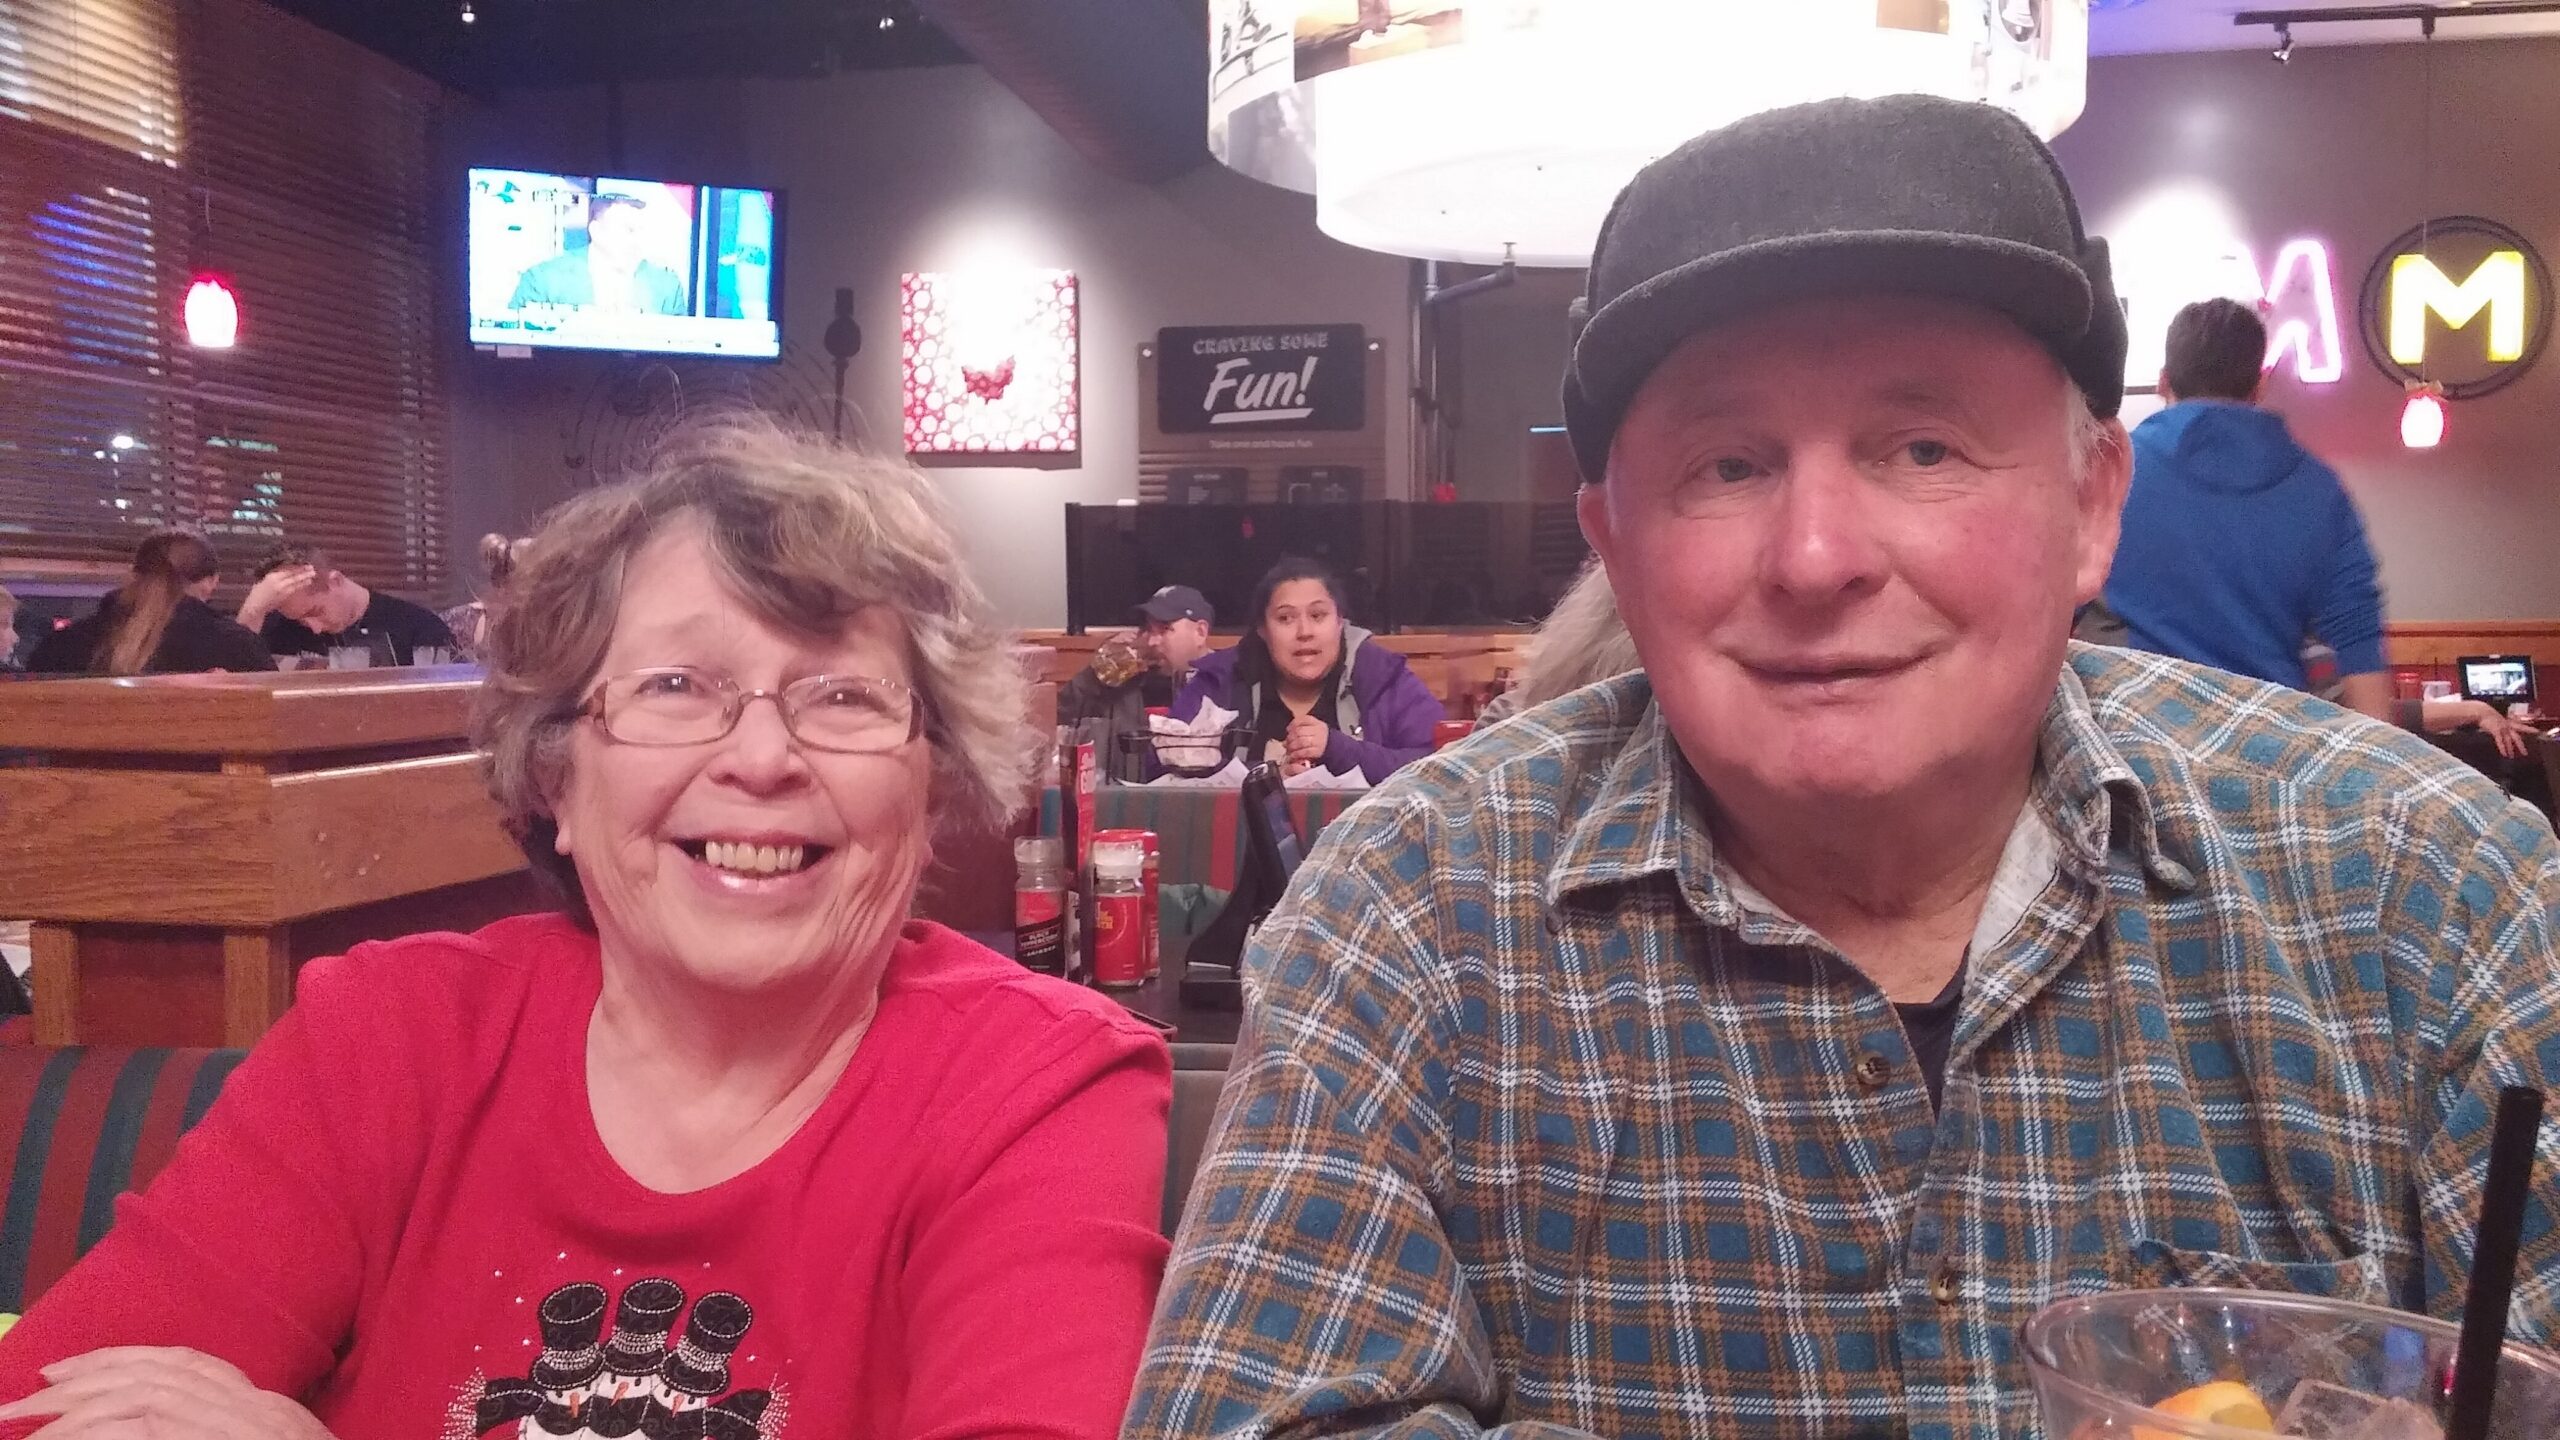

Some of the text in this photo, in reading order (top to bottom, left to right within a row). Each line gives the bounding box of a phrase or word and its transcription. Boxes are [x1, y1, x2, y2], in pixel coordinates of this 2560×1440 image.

[2390, 251, 2525, 364] M
[1192, 331, 1328, 355] CRAVING SOME
[1203, 355, 1319, 412] Fun!
